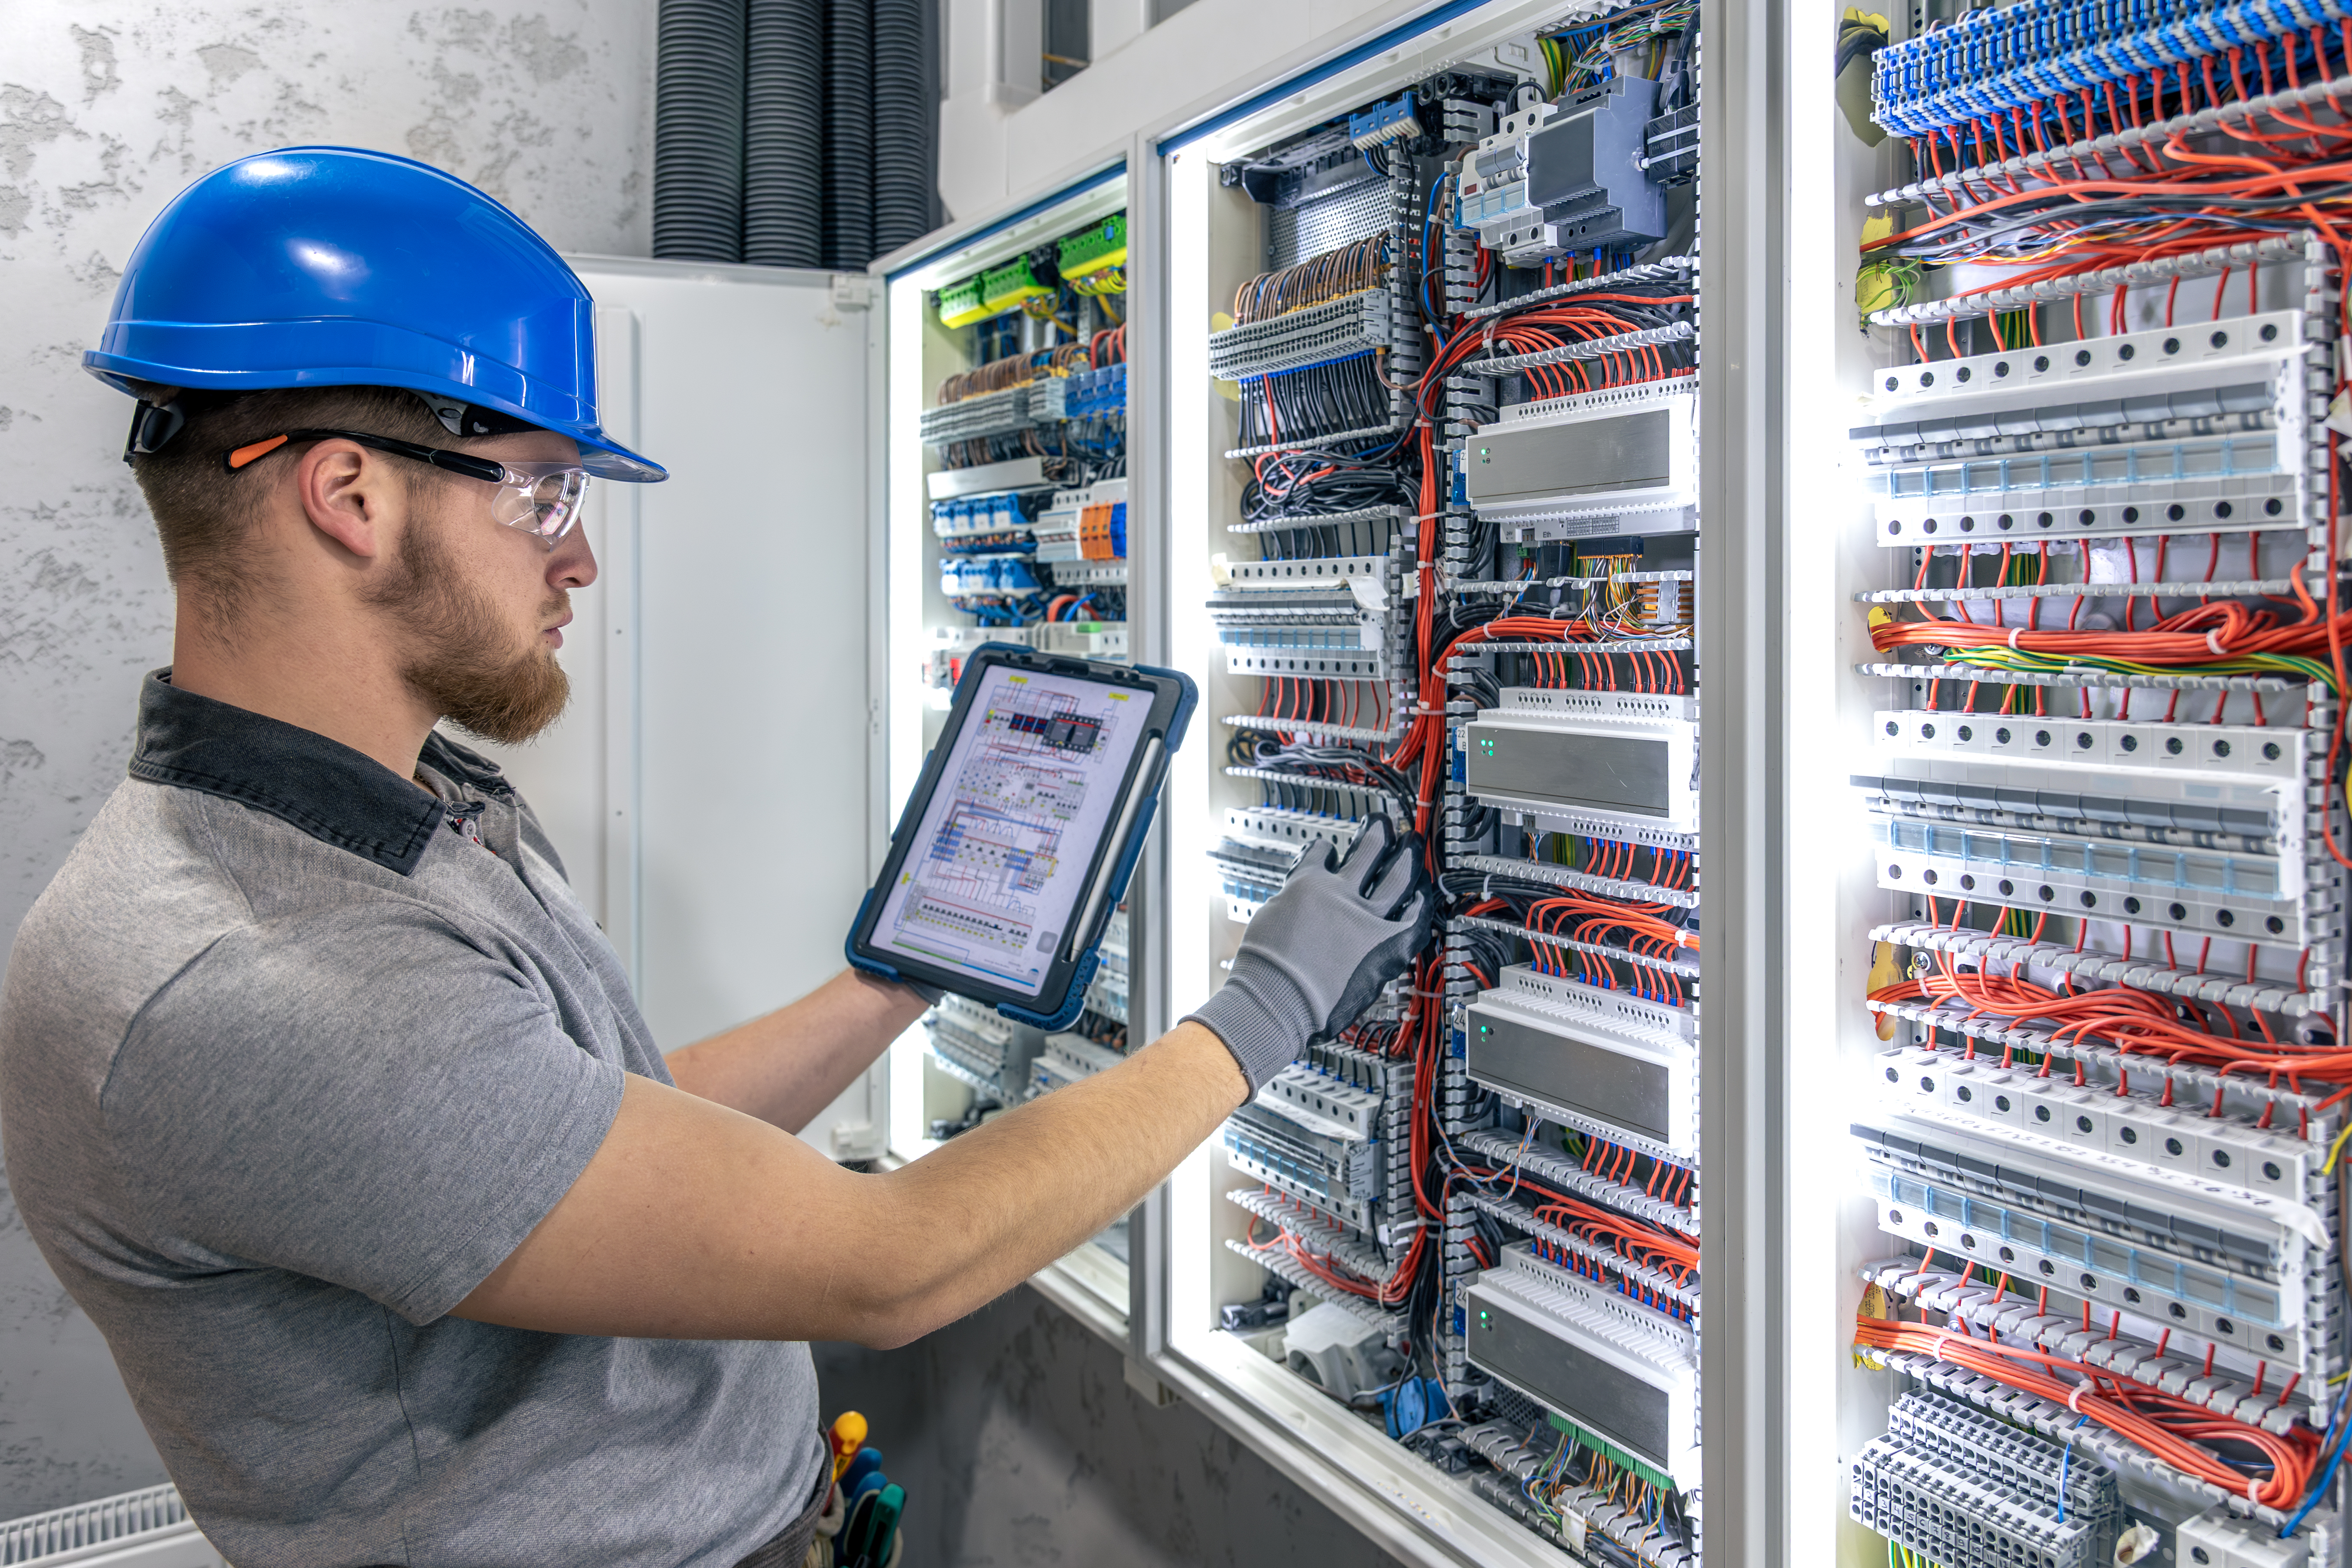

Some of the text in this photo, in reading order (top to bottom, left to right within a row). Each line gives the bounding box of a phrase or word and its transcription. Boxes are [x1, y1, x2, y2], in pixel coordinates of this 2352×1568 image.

[1458, 729, 1465, 738] 22
[1454, 1012, 1465, 1026] 24
[1854, 1485, 1857, 1494] 1
[1866, 1491, 1873, 1501] 2
[1881, 1500, 1887, 1508] 3
[1894, 1505, 1900, 1514] 4
[1933, 1526, 1939, 1534] 7
[1945, 1532, 1950, 1540] 8
[1987, 1553, 1992, 1561] 11
